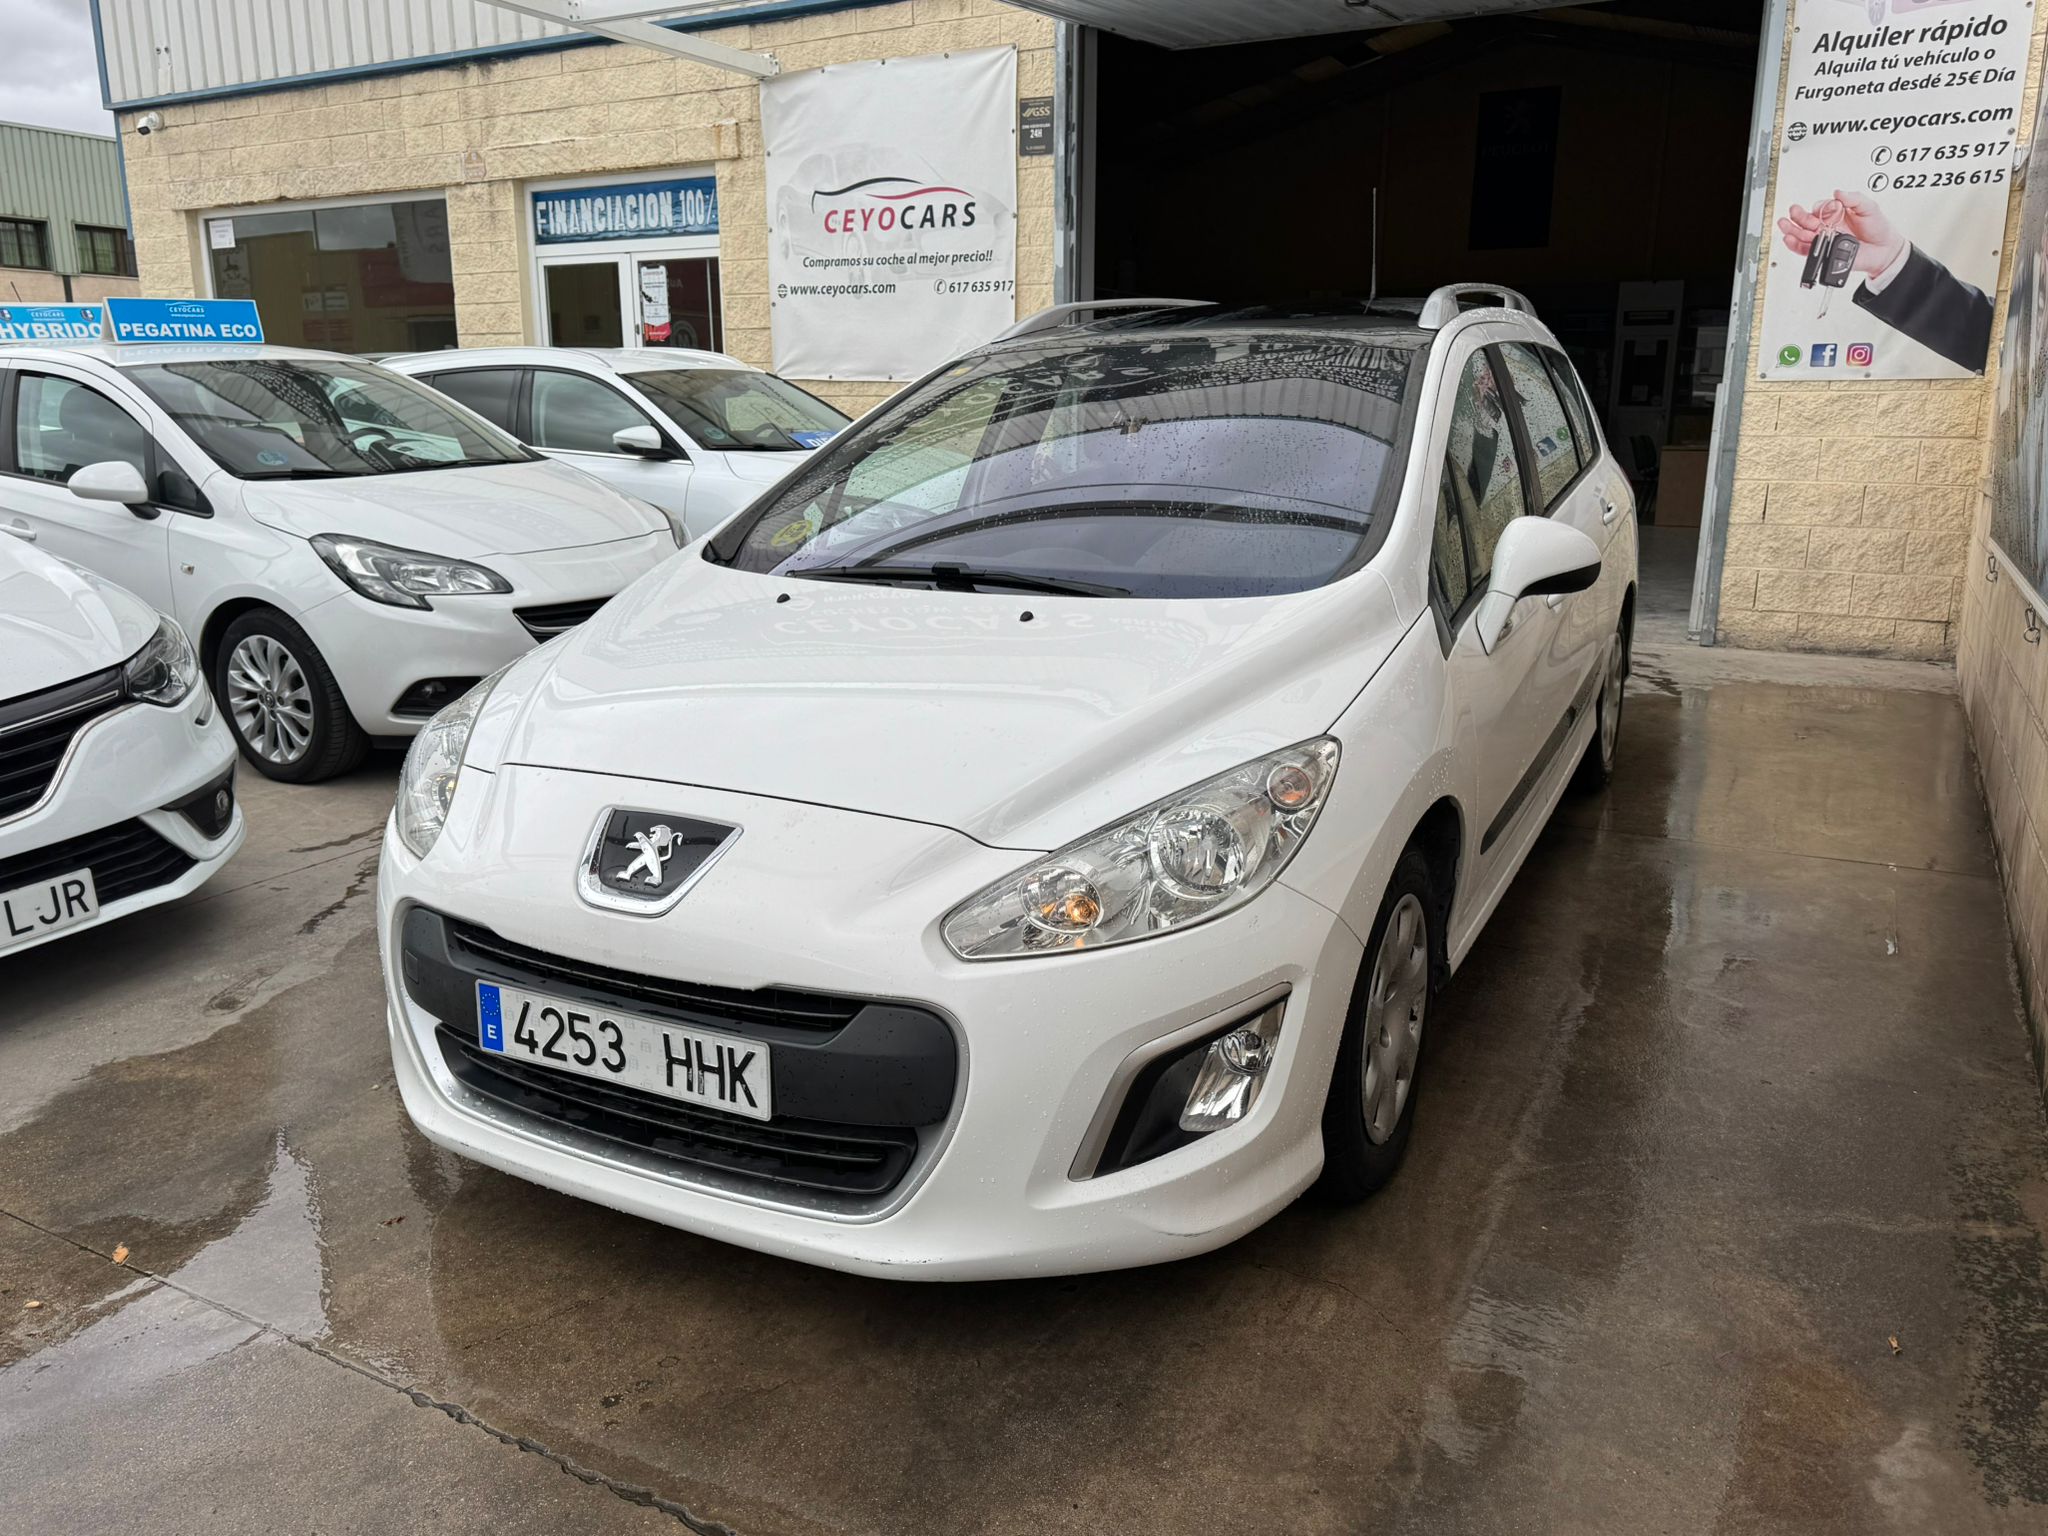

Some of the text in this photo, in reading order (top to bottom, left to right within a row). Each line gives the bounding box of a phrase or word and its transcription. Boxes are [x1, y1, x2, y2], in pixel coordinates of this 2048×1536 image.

[1812, 14, 2008, 55] Alquiler rápido
[1814, 47, 1996, 77] Alquila tú vehículo o
[1795, 67, 2016, 101] Furgoneta desdé 25€ Día
[1812, 107, 2013, 135] www.ceyocars.com
[1896, 141, 2009, 163] 617 635 917
[1893, 168, 2005, 190] 622 236 615
[536, 191, 673, 235] FINANCIACION
[824, 202, 976, 233] CEYOCARS
[803, 250, 993, 269] Compramos su coche al mejor precio!!
[790, 282, 896, 298] www.ceyocars.com
[949, 279, 1013, 293] 617 635 917
[0, 322, 101, 339] HYBRIDO
[119, 322, 257, 338] PEGATINA ECO
[487, 1023, 498, 1040] E
[514, 1001, 758, 1109] 4253 HHK
